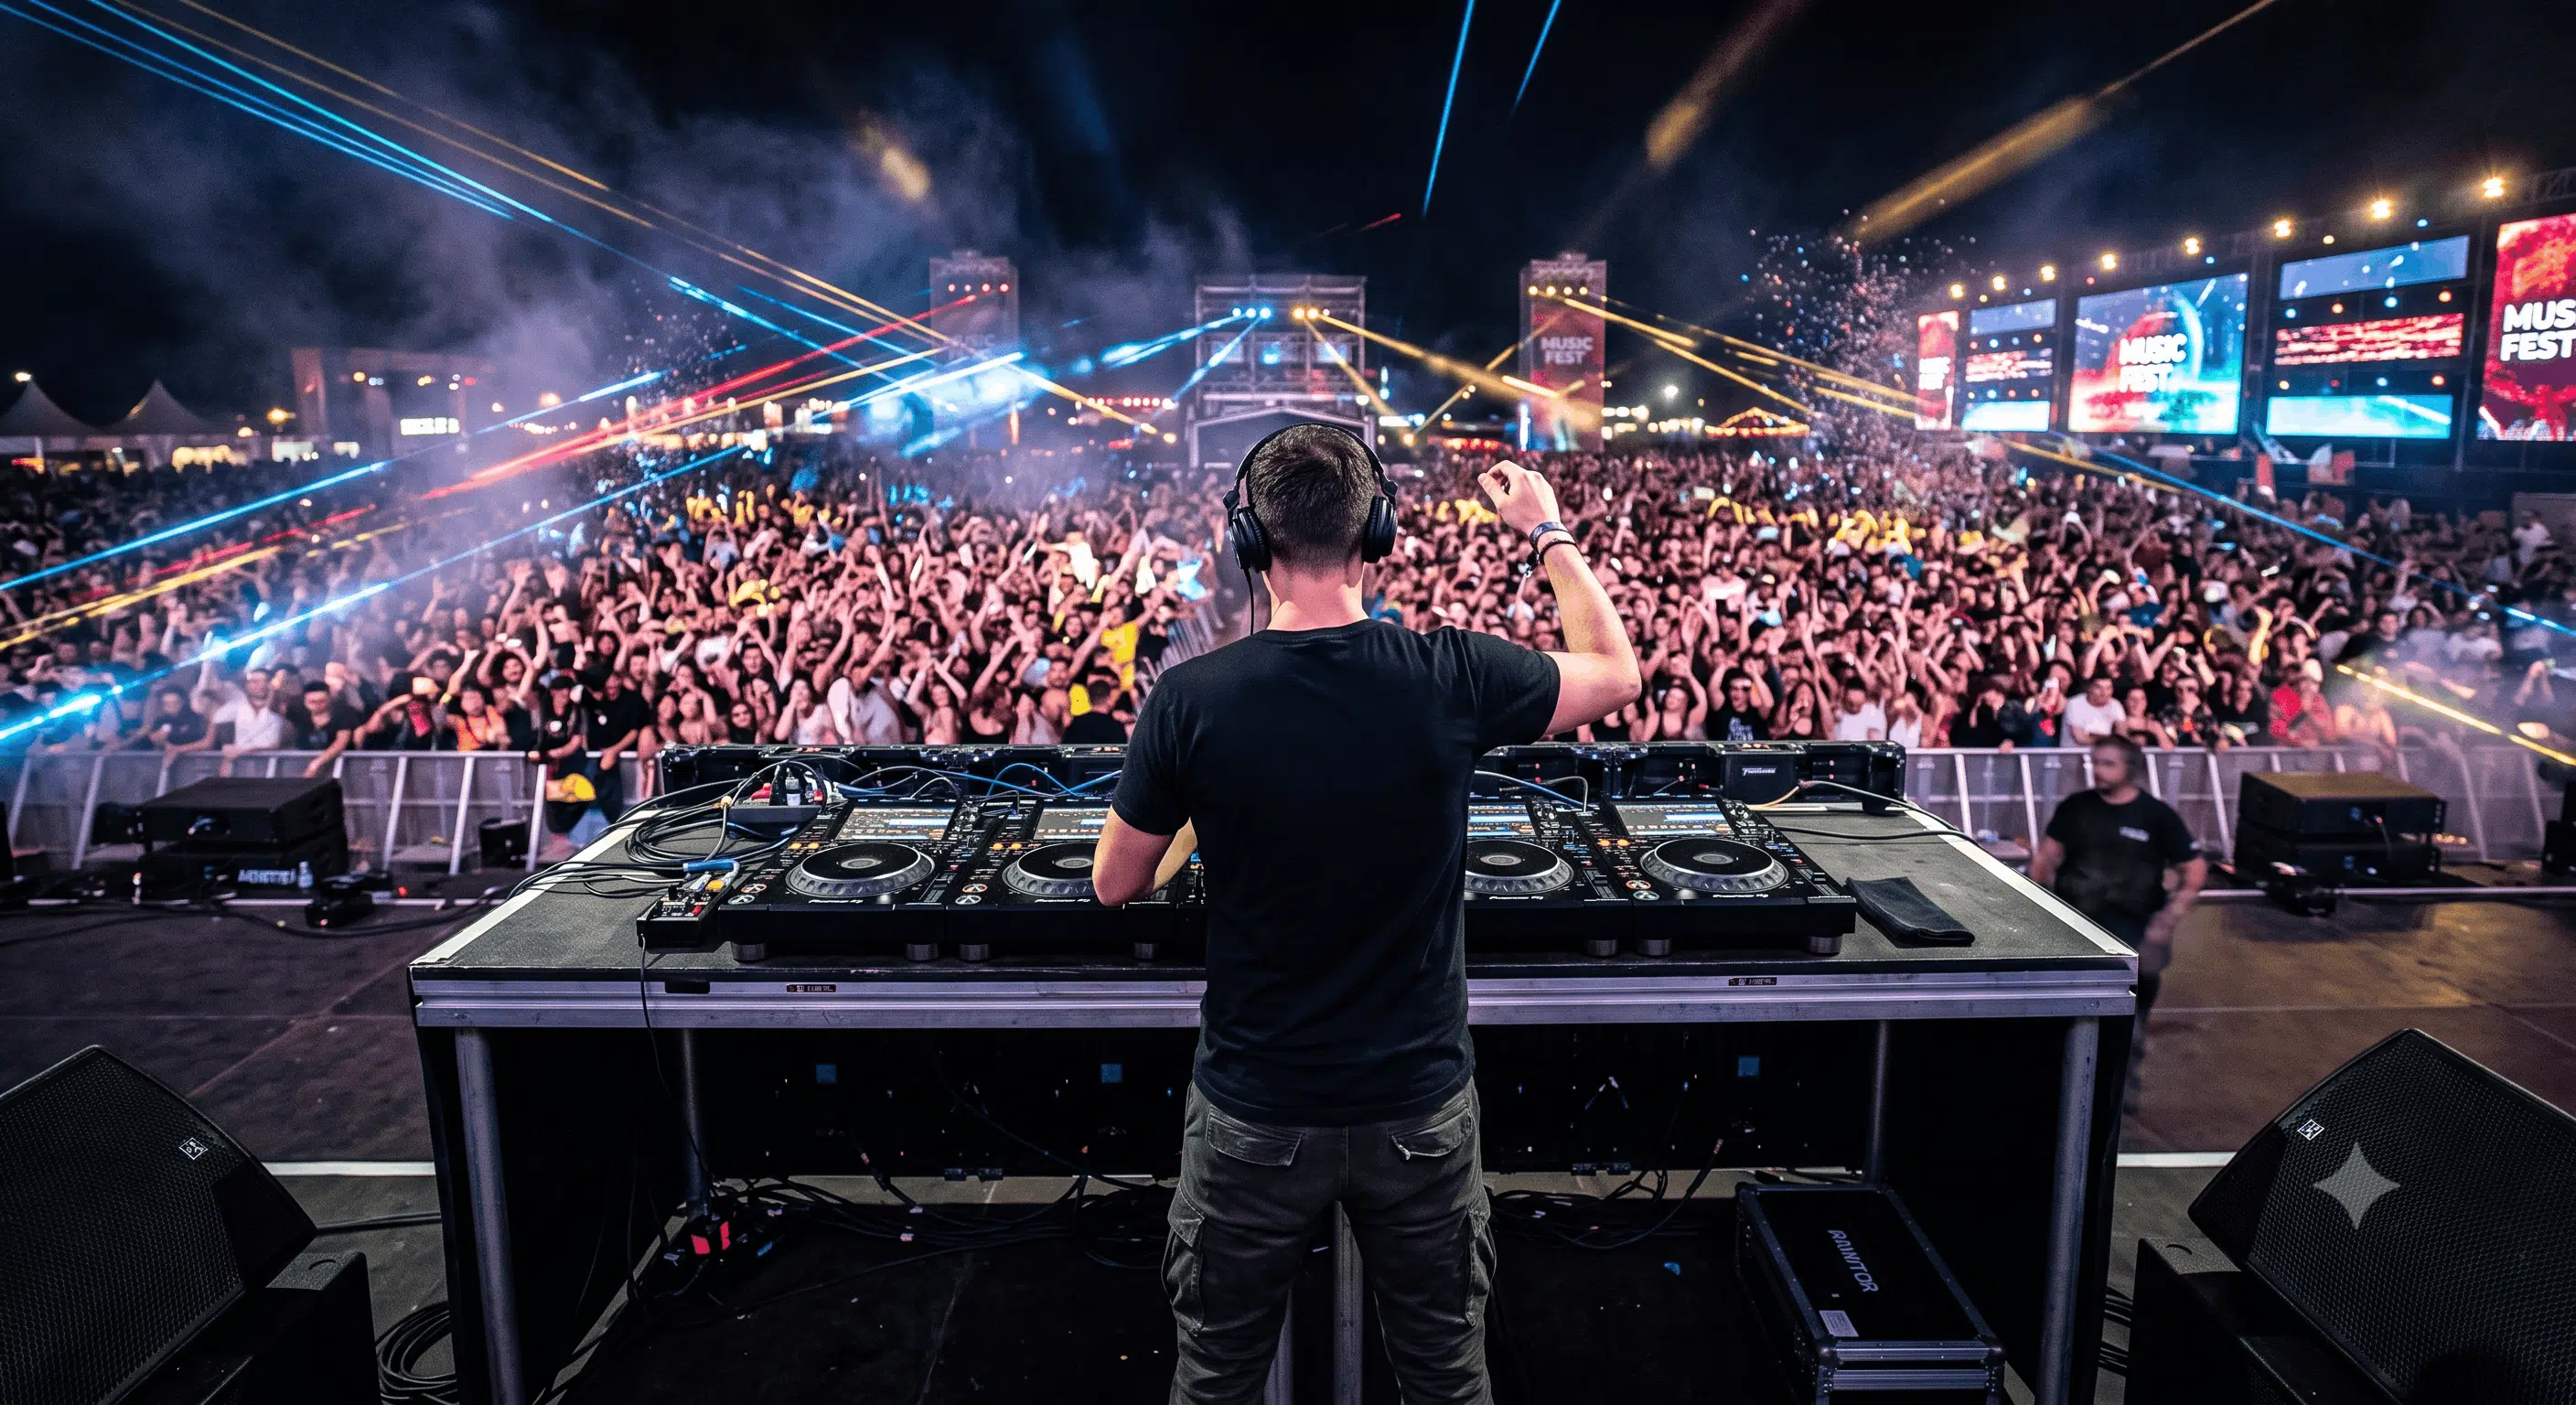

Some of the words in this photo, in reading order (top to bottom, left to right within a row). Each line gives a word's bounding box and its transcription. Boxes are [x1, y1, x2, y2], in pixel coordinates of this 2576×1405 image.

[2503, 298, 2576, 332] MUS
[1540, 336, 1594, 351] MUSIC
[1544, 350, 1588, 365] FEST
[2119, 333, 2187, 365] MUSIC
[2500, 328, 2576, 361] FEST
[2119, 363, 2174, 393] FEST
